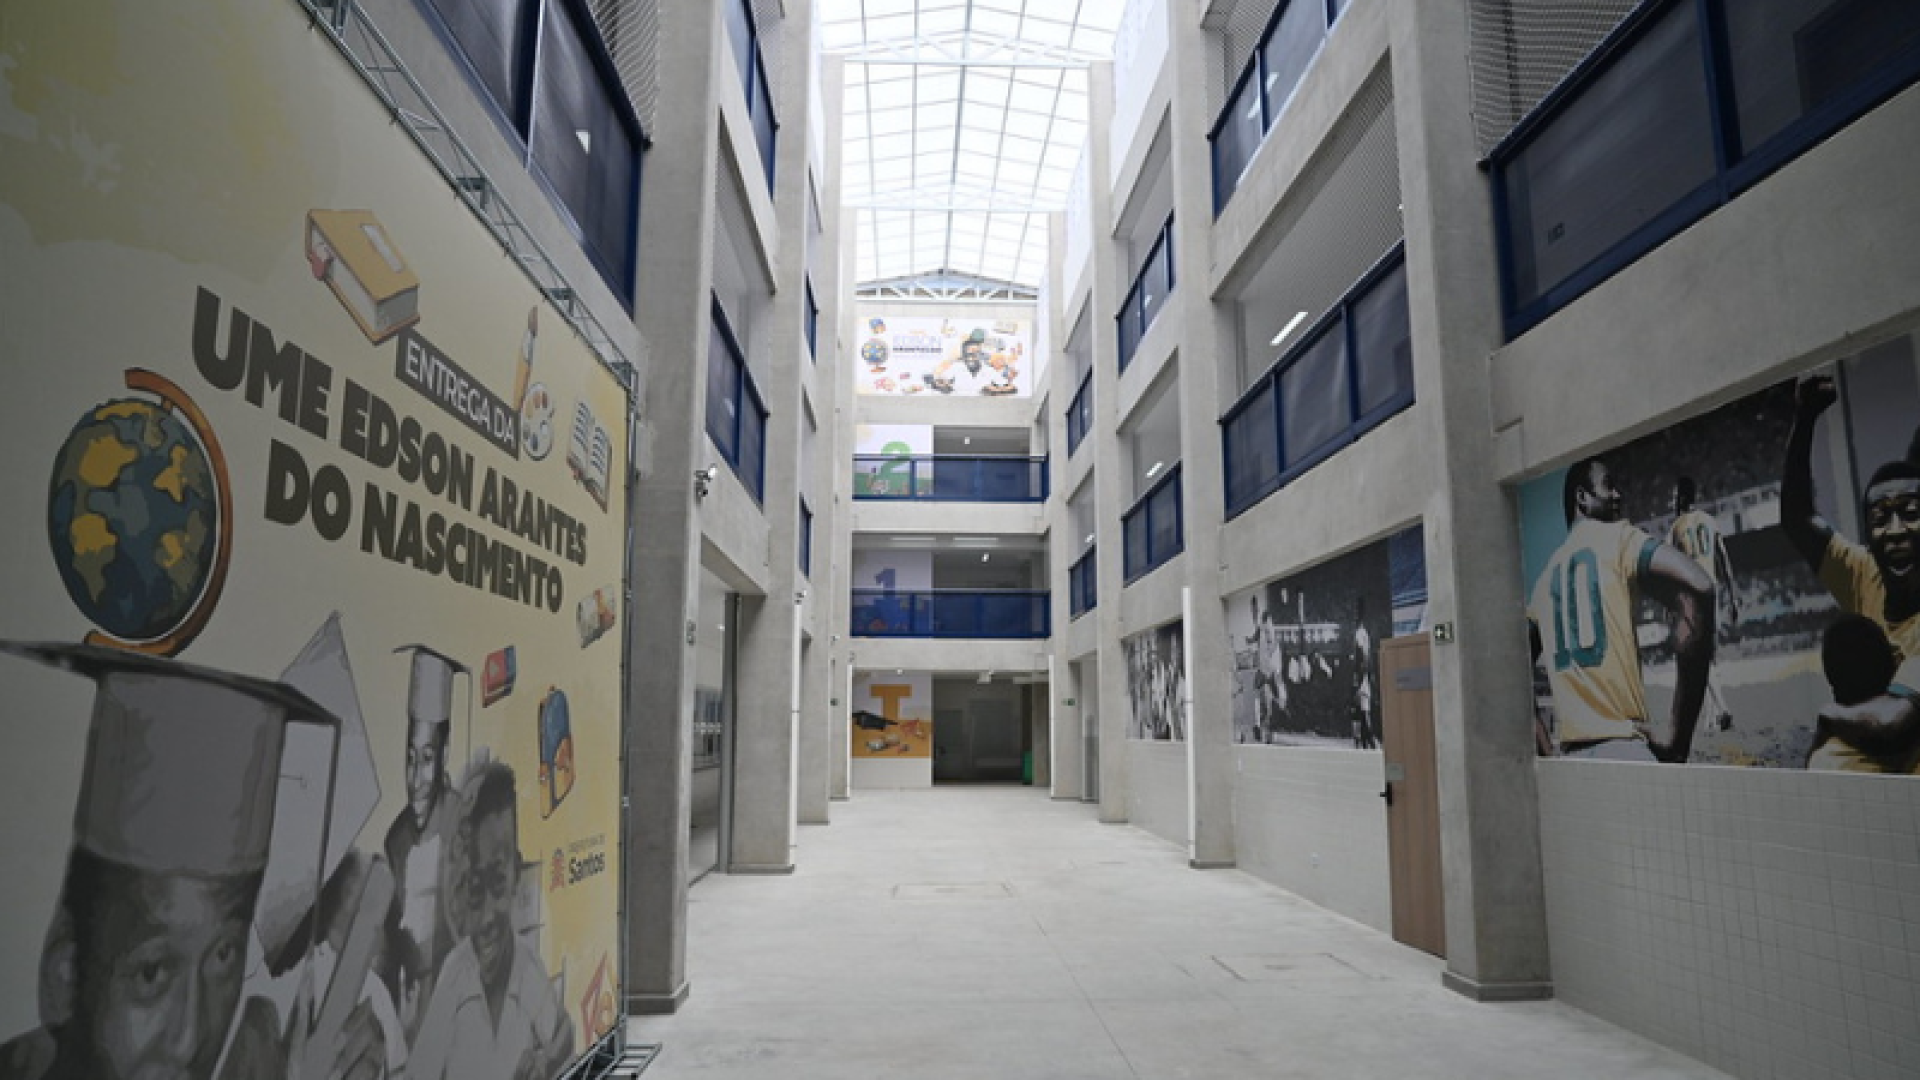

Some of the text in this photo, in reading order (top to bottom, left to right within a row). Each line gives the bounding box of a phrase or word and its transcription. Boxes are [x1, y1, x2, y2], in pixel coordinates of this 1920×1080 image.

[192, 286, 587, 567] UME EDSON ARANTES
[405, 338, 517, 450] ENTREGA DA
[264, 438, 564, 613] DO NASCIMENTO
[1686, 523, 1709, 556] 10
[1551, 547, 1607, 671] 10
[568, 852, 606, 884] Santos
